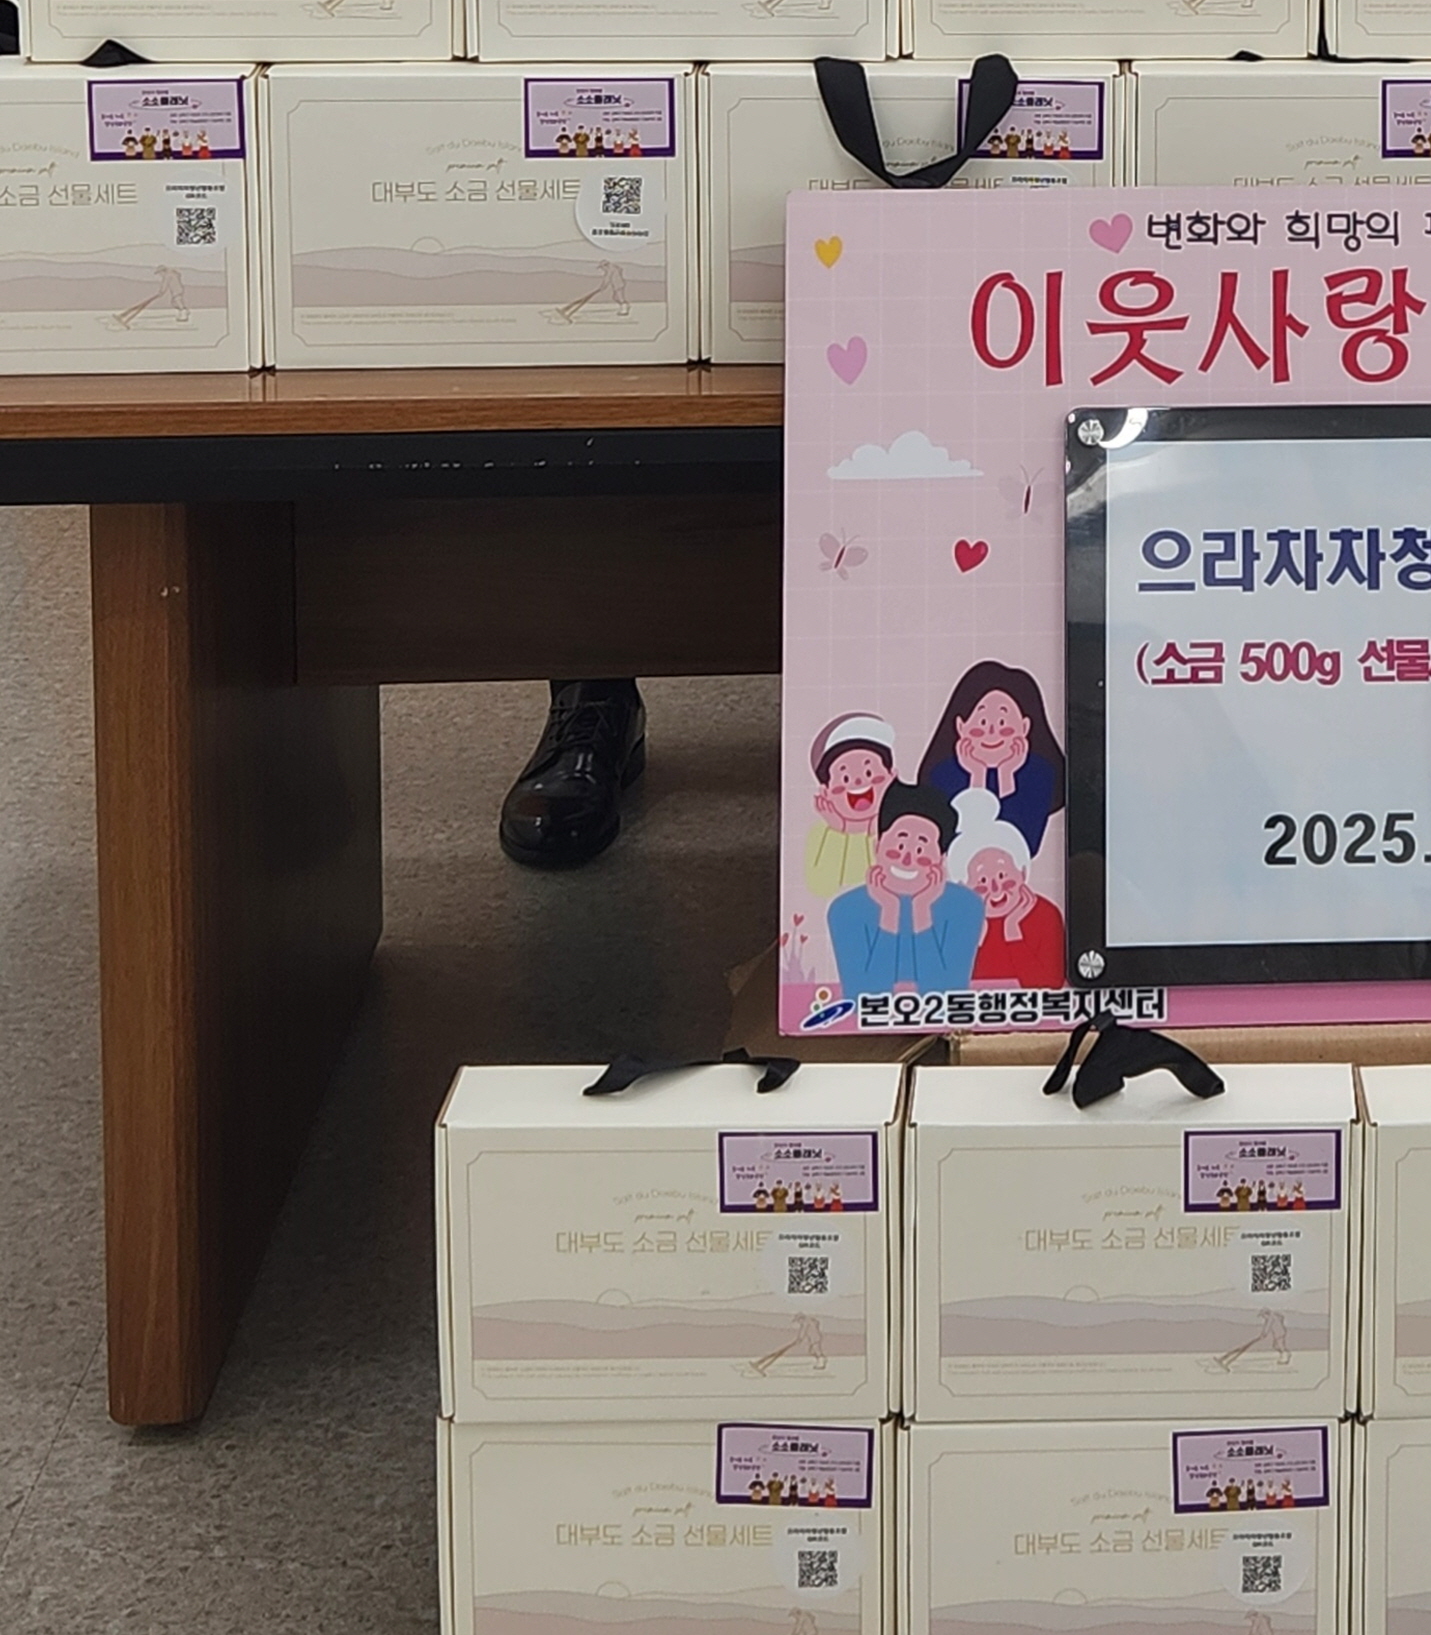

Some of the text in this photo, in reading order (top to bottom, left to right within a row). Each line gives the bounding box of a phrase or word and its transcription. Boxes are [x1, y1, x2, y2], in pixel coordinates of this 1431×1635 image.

[0, 184, 40, 207] 소금
[48, 183, 138, 207] 선물세트
[372, 179, 581, 204] 대부도 소금 선물세트
[1145, 211, 1267, 248] 변화와
[1285, 210, 1401, 252] 희망의
[969, 265, 1429, 388] 이웃사랑
[1135, 640, 1227, 686] (소금
[1239, 639, 1342, 685] 500g
[858, 988, 1166, 1027] 본오2동행정복지센터
[555, 1230, 625, 1255] 대부도
[632, 1231, 678, 1254] 소금
[1023, 1228, 1093, 1253] 대부도
[1100, 1228, 1147, 1251] 소금
[556, 1523, 625, 1547] 대부도
[631, 1523, 676, 1546] 소금
[683, 1523, 774, 1547] 선물세트
[1014, 1531, 1082, 1556] 대부도
[1089, 1530, 1135, 1554] 소금
